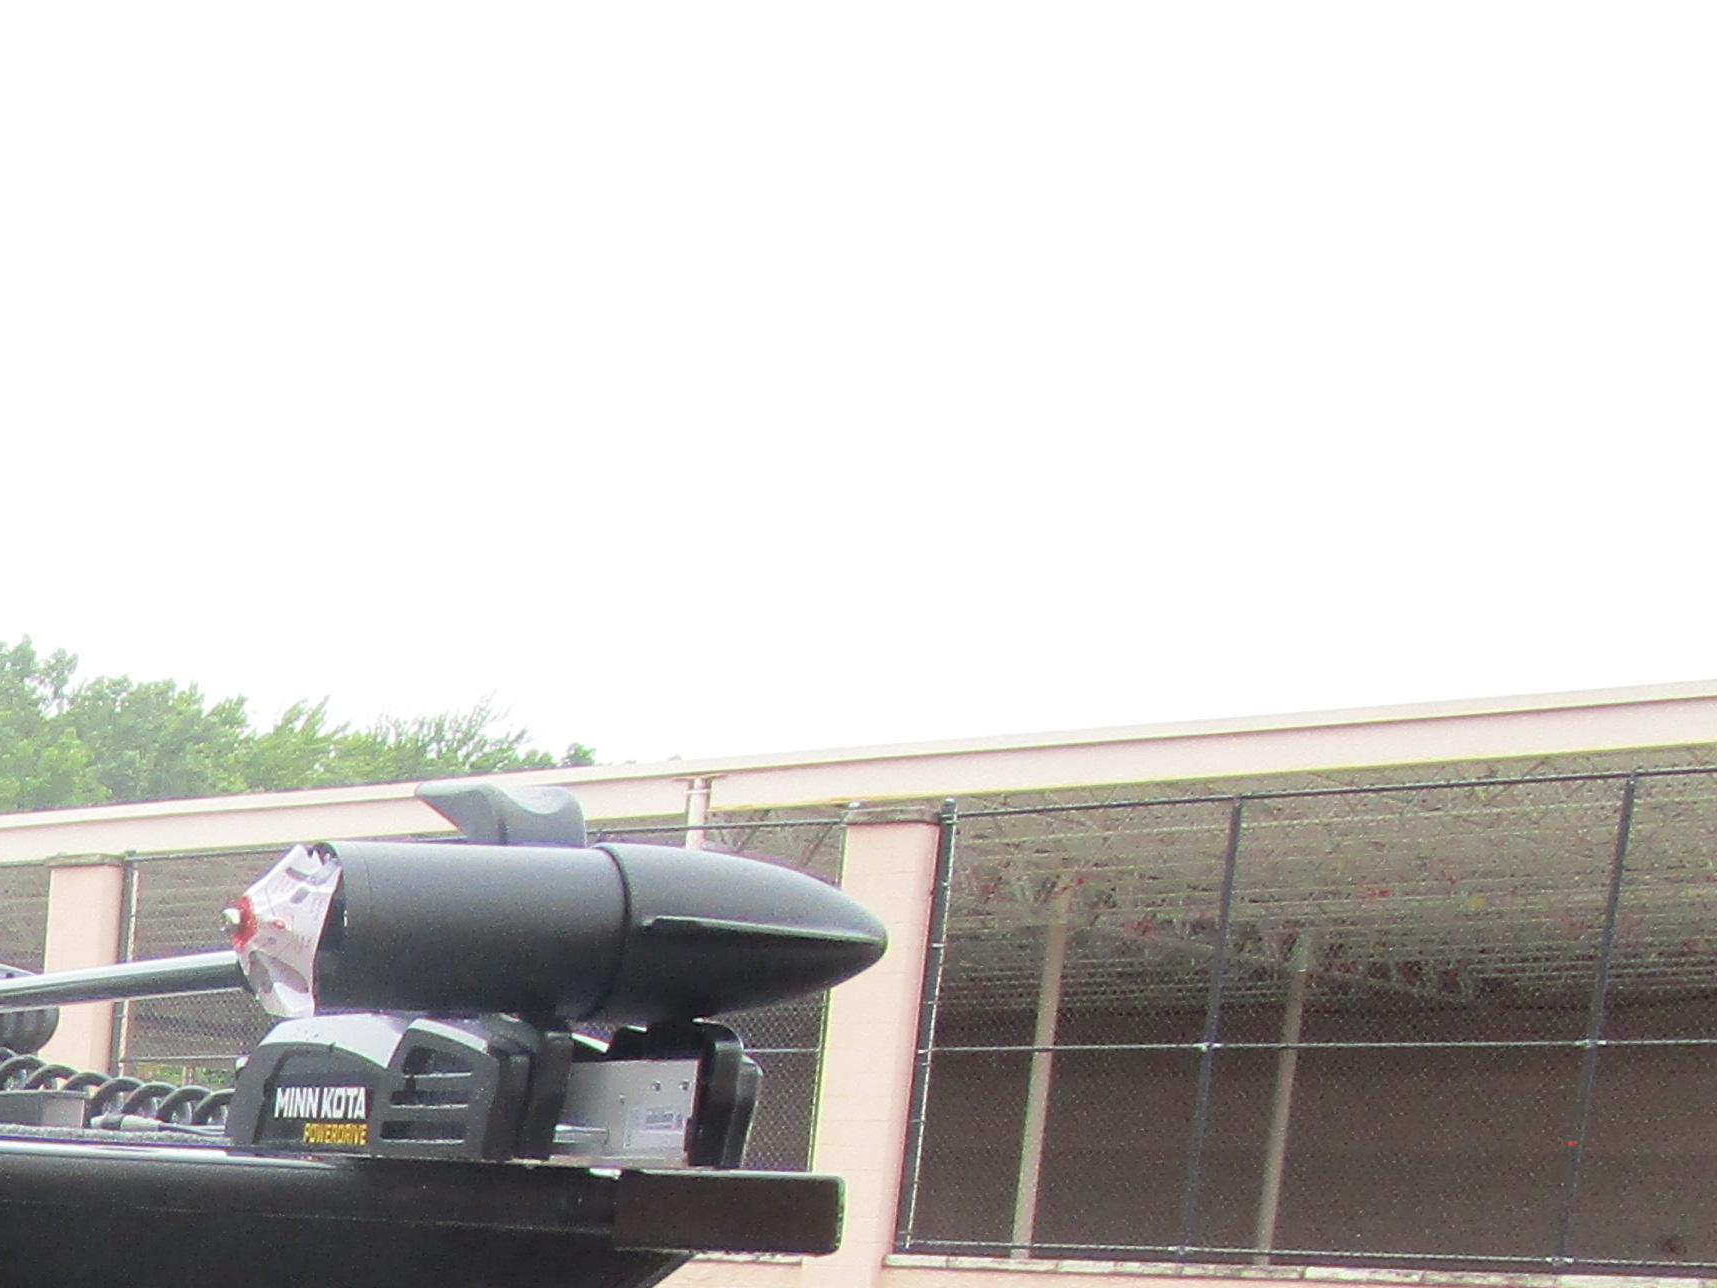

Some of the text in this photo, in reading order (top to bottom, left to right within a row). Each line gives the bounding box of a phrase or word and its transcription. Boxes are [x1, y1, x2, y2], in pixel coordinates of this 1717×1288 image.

[274, 1086, 366, 1119] MINN KOTA
[303, 1122, 368, 1145] POWERDRIVE
